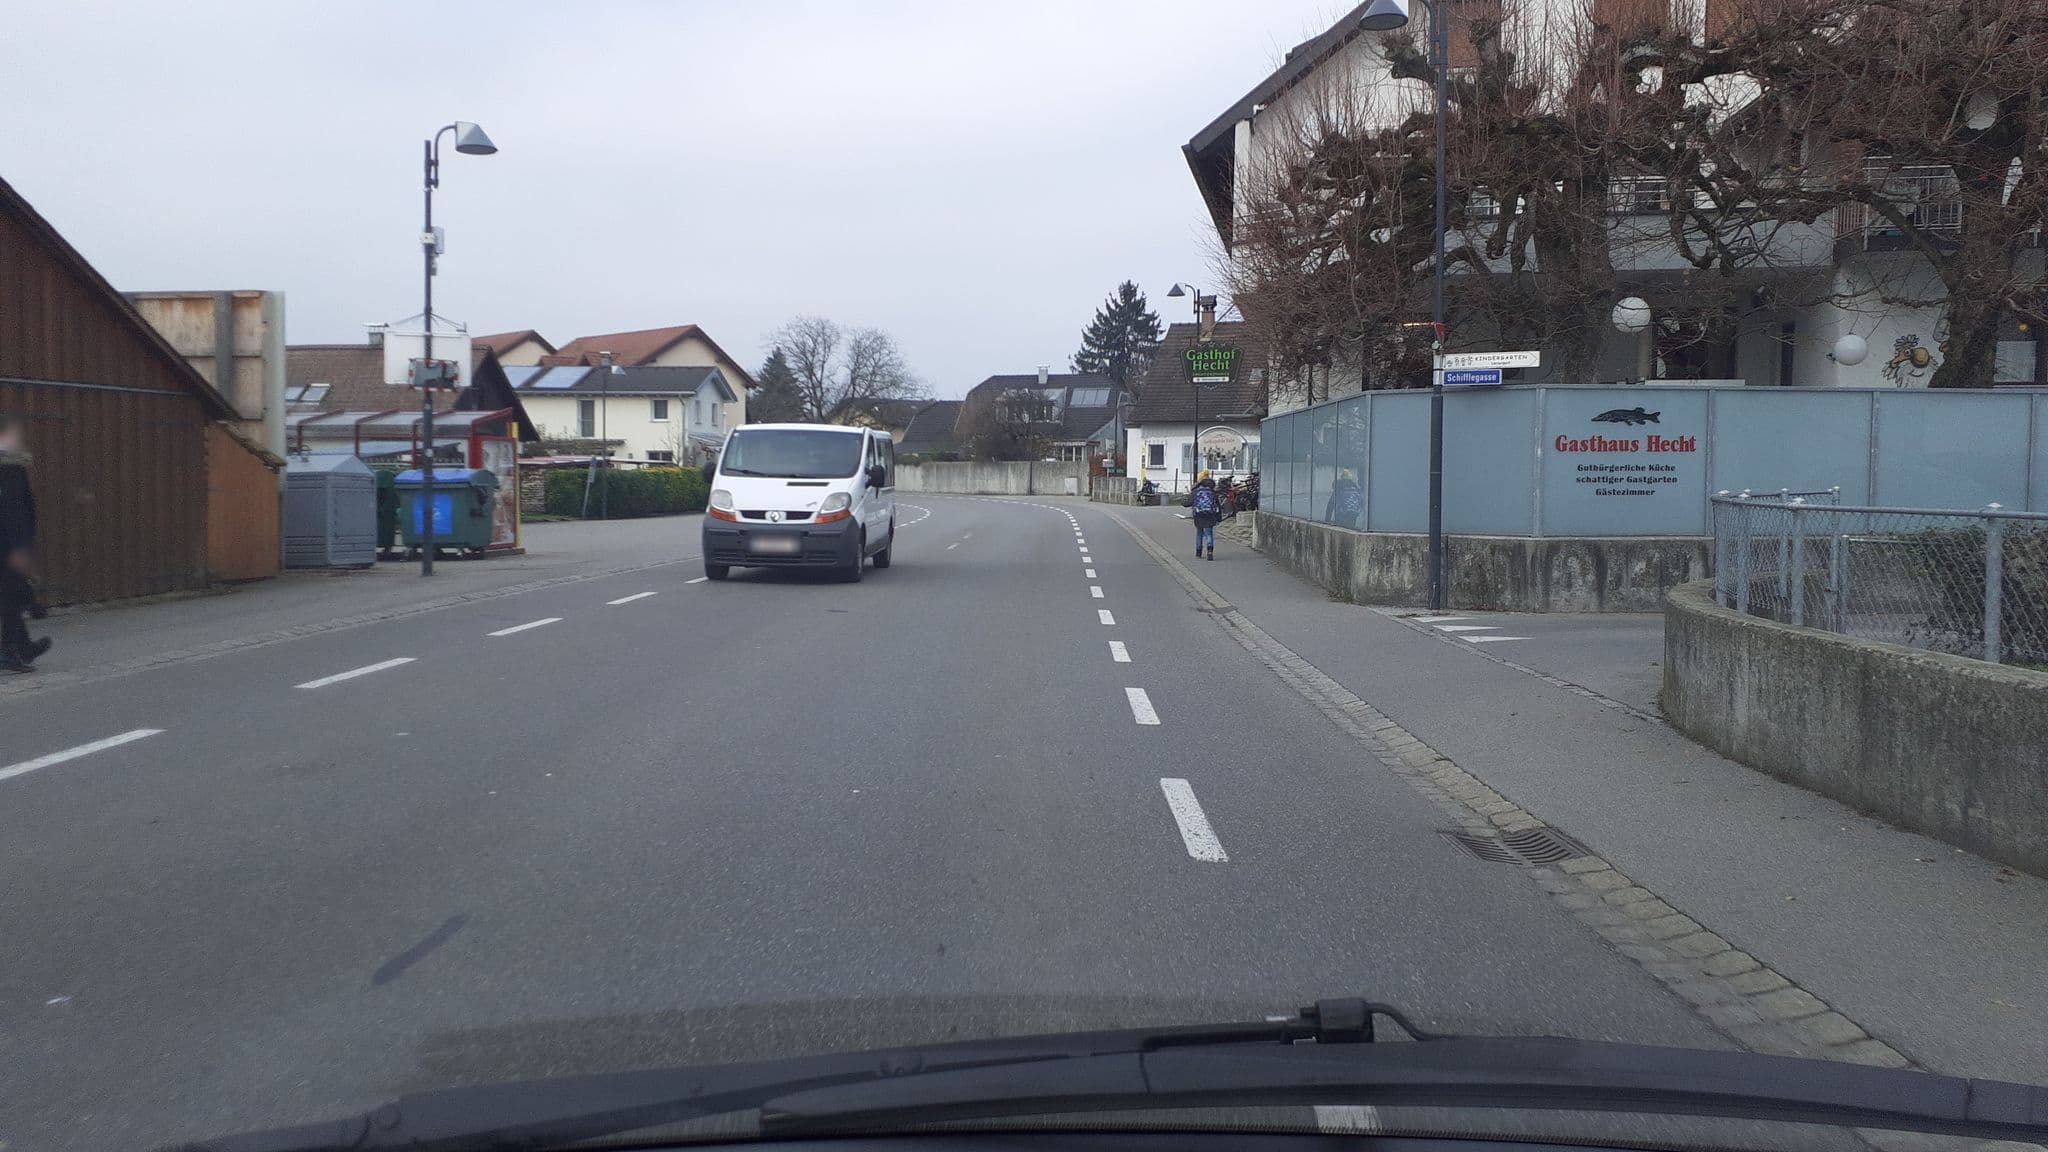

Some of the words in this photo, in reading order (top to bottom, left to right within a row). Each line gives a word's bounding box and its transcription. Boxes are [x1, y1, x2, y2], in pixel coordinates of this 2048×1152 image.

[1186, 349, 1236, 360] Gasthof
[1192, 360, 1230, 371] Hecht
[1447, 373, 1497, 384] Schifflegasse
[1555, 434, 1640, 452] Gasthaus
[1647, 434, 1697, 452] Hecht
[1577, 463, 1646, 473] Gutbürgerliche
[1648, 463, 1676, 472] Küche
[1576, 475, 1624, 485] schattiger
[1626, 475, 1677, 485] Gastgarten
[1595, 487, 1656, 496] Gästezimmer
